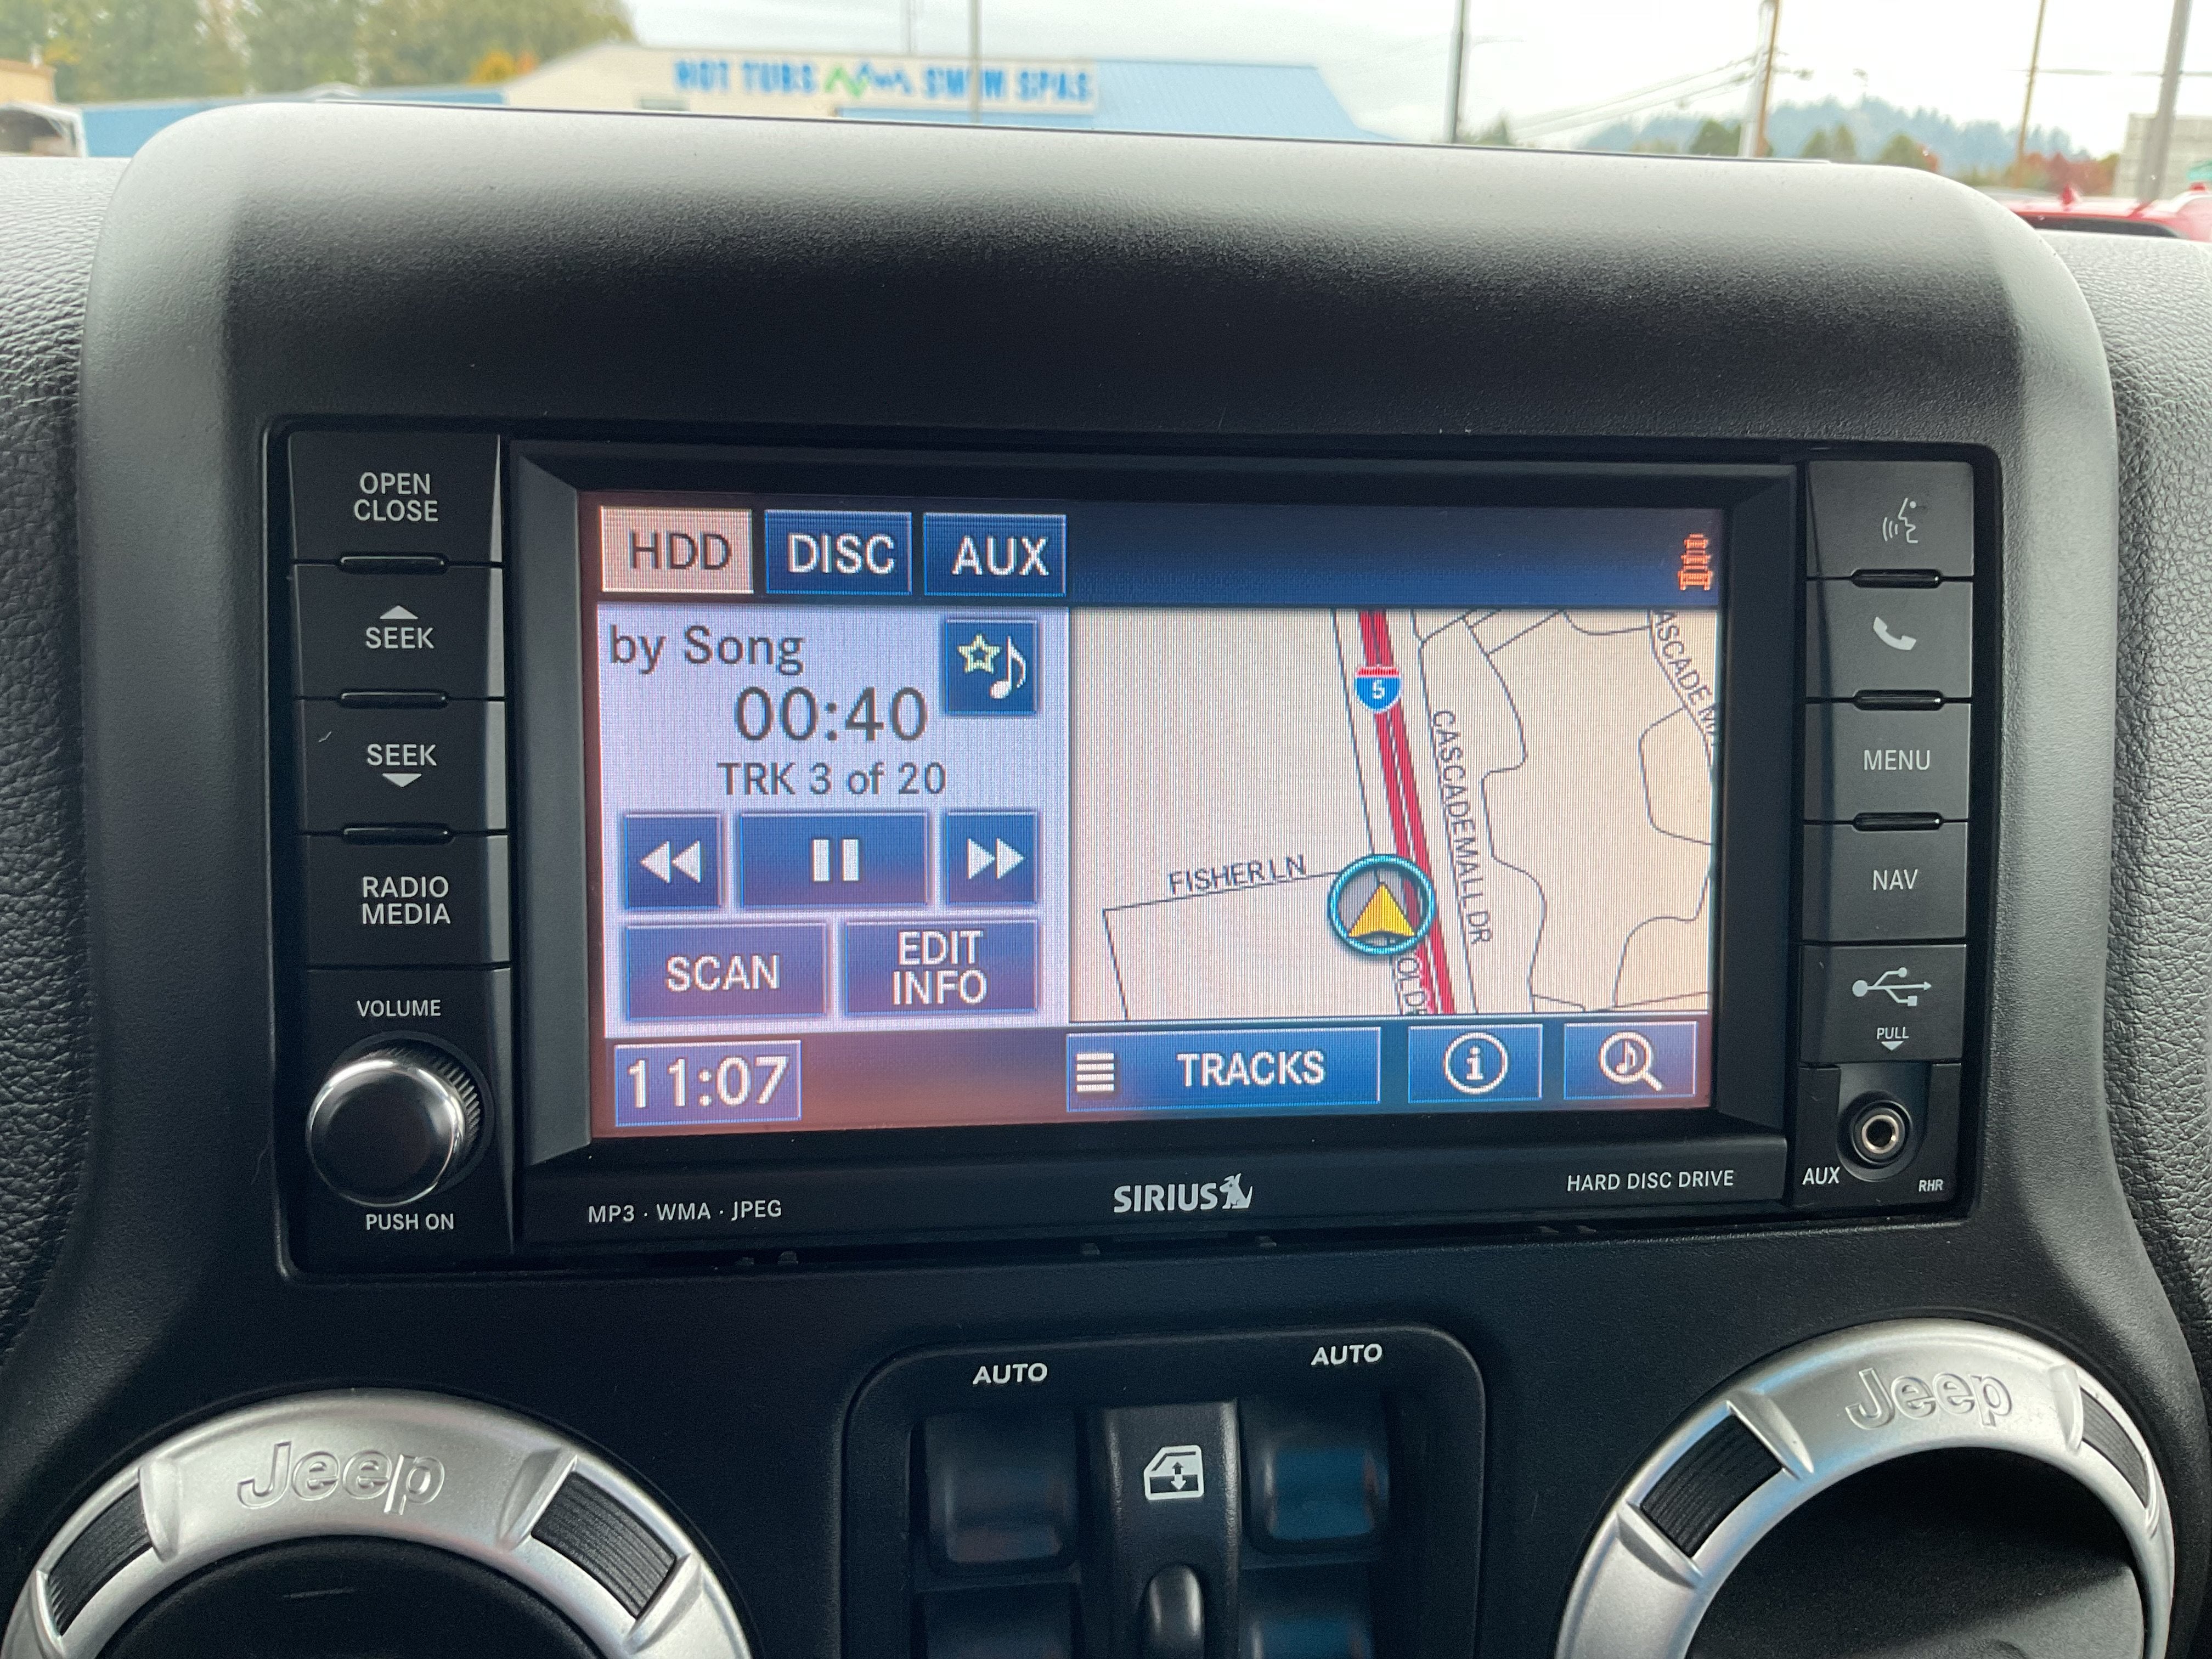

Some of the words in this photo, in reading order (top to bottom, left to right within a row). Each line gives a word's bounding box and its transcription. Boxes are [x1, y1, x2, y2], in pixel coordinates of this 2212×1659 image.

[924, 66, 1007, 101] SWM
[359, 471, 431, 495] OPEN
[353, 498, 439, 523] CLOSE
[629, 531, 733, 572] HDD
[787, 532, 896, 575] DISC
[951, 534, 1050, 577] AUX
[365, 626, 435, 650] SEEK
[608, 624, 667, 675] by
[682, 624, 805, 677] Song
[1372, 679, 1386, 700] 5
[733, 686, 928, 742] 00:40
[366, 743, 438, 767] SEEK
[1863, 749, 1932, 771] MENU
[715, 761, 797, 796] TRK
[808, 761, 833, 796] 3
[845, 760, 885, 796] of
[897, 761, 947, 796] 20
[1168, 859, 1265, 895] FISHER
[1268, 854, 1307, 881] LN
[1872, 868, 1919, 891] NAV
[362, 876, 450, 899] RADIO
[361, 902, 452, 926] MEDIA
[1465, 910, 1492, 945] DR
[898, 930, 984, 966] EDIT
[666, 954, 781, 992] SCAN
[891, 968, 988, 1006] INFO
[356, 999, 442, 1018] VOLUME
[1876, 1026, 1909, 1040] PULL
[1176, 1048, 1327, 1088] TRACKS
[627, 1054, 789, 1109] 11:07
[1566, 1173, 1621, 1193] HARD
[1626, 1171, 1672, 1190] DISC
[1677, 1169, 1735, 1189] DRIVE
[1802, 1166, 1841, 1186] AUX
[1918, 1178, 1945, 1193] RHR
[588, 1204, 635, 1223] MP3
[655, 1202, 712, 1221] WMA
[731, 1199, 782, 1221] JPEG
[1113, 1184, 1218, 1214] SIRIUS
[365, 1213, 419, 1231] PUSH
[425, 1212, 455, 1231] ON
[1310, 1343, 1384, 1366] AUTO
[972, 1362, 1048, 1385] AUTO
[1843, 1367, 2014, 1429] Jeep
[236, 1440, 446, 1516] Jeep
